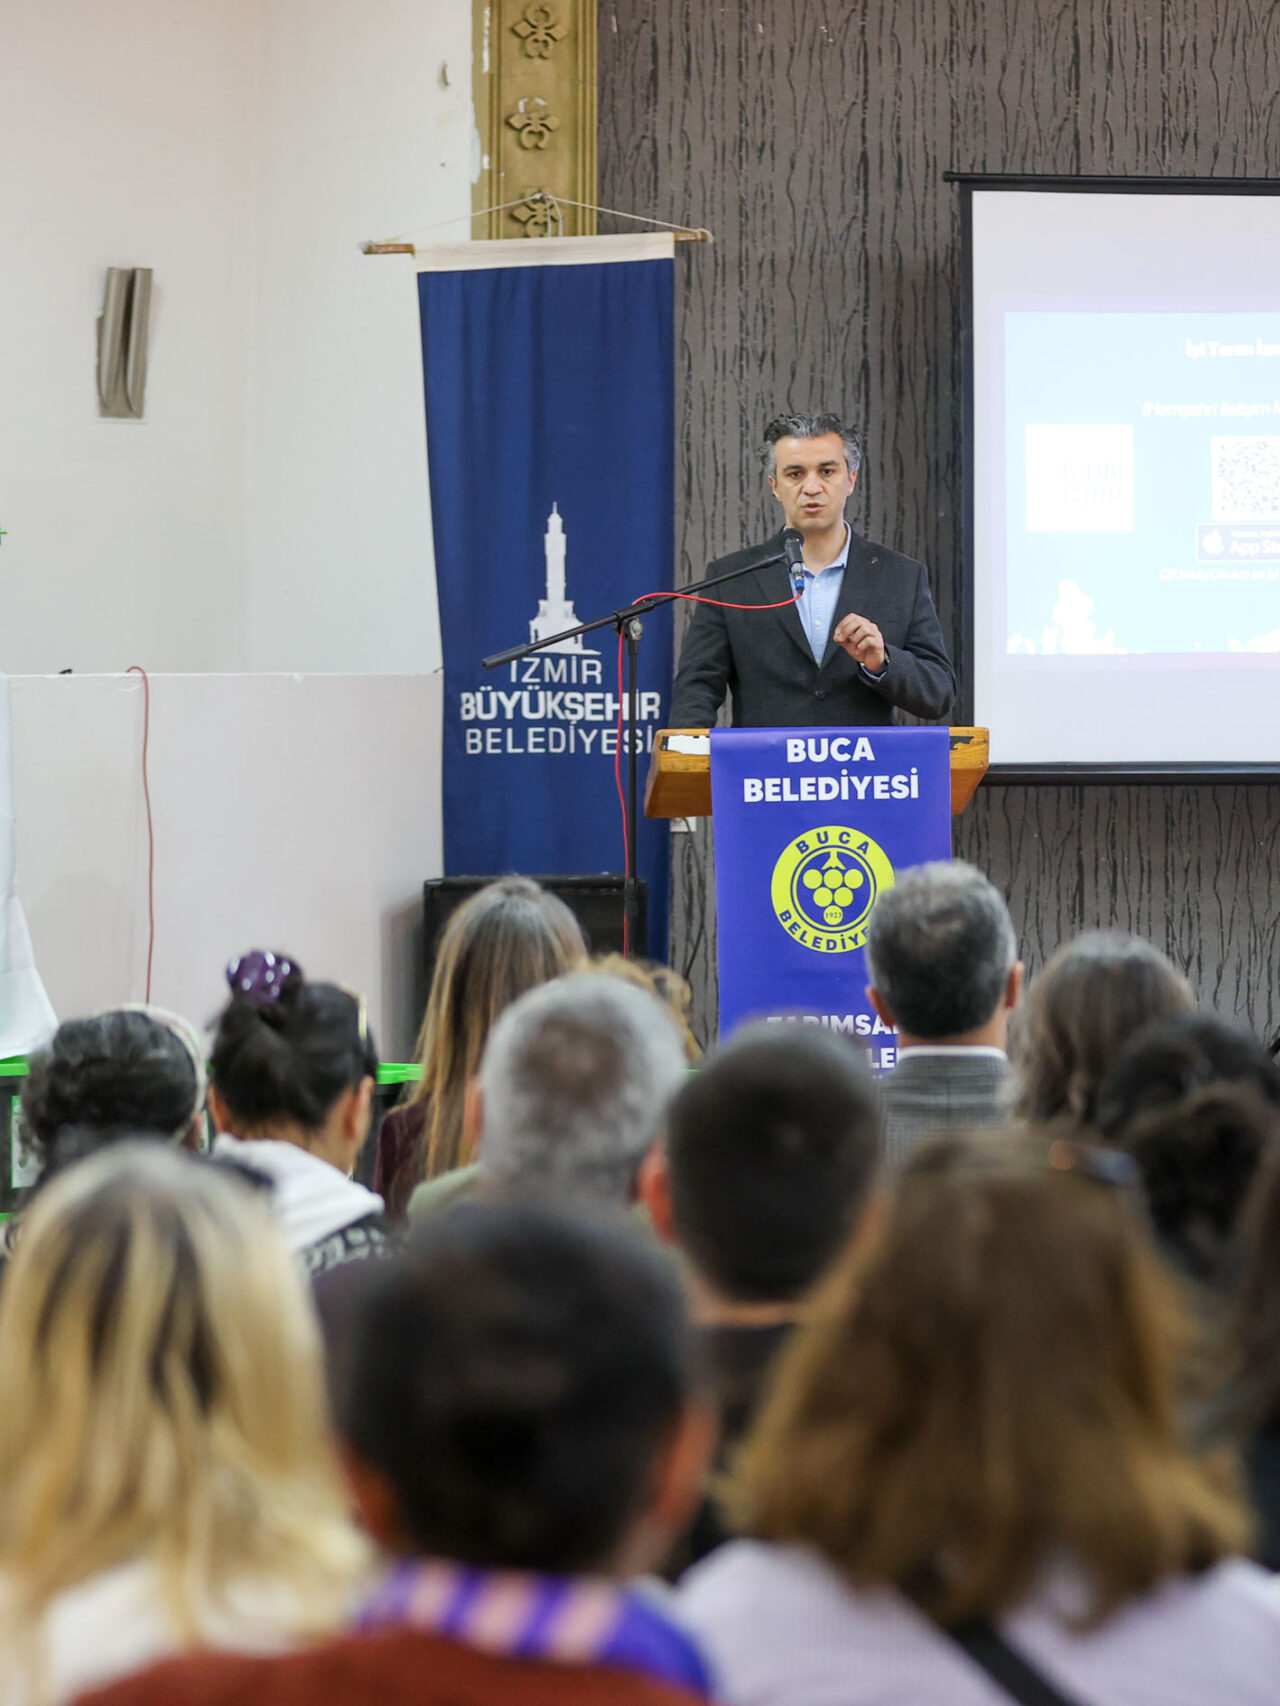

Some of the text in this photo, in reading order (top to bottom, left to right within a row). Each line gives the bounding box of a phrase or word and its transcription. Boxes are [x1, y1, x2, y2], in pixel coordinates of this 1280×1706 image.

[1229, 540, 1260, 557] App
[786, 738, 876, 763] BUCA
[743, 767, 919, 803] BELEDİYESİ
[795, 831, 870, 854] BUCA
[779, 910, 870, 950] BELEDİYE
